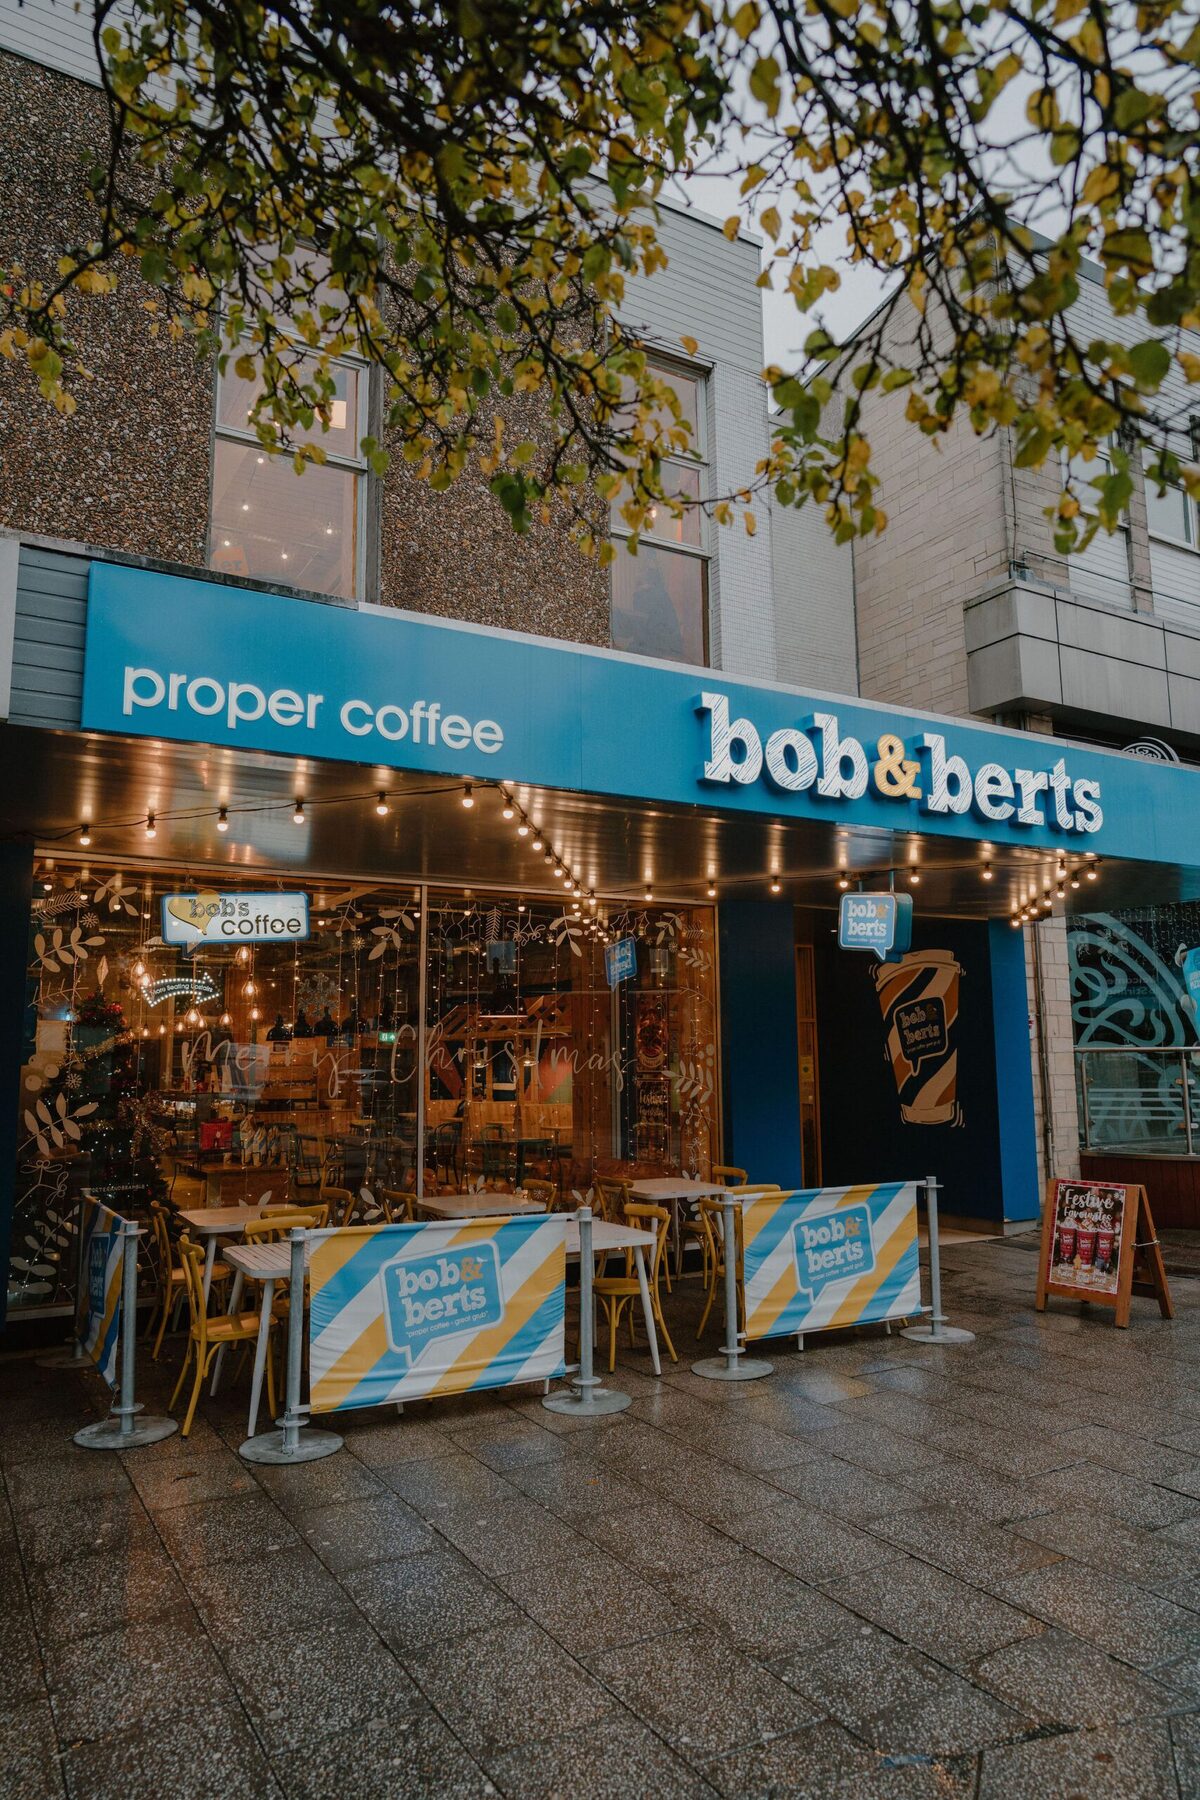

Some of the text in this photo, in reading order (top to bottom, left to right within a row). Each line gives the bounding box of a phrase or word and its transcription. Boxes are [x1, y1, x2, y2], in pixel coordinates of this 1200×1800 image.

[122, 666, 504, 754] proper coffee
[188, 898, 250, 918] bob's
[221, 914, 301, 936] coffee
[847, 918, 887, 937] berts
[167, 983, 190, 992] Seating
[903, 1023, 940, 1045] berts
[181, 1018, 637, 1098] Merry Christmas
[1065, 1188, 1114, 1209] Festive
[806, 1239, 864, 1273] berts
[402, 1284, 487, 1328] berts
